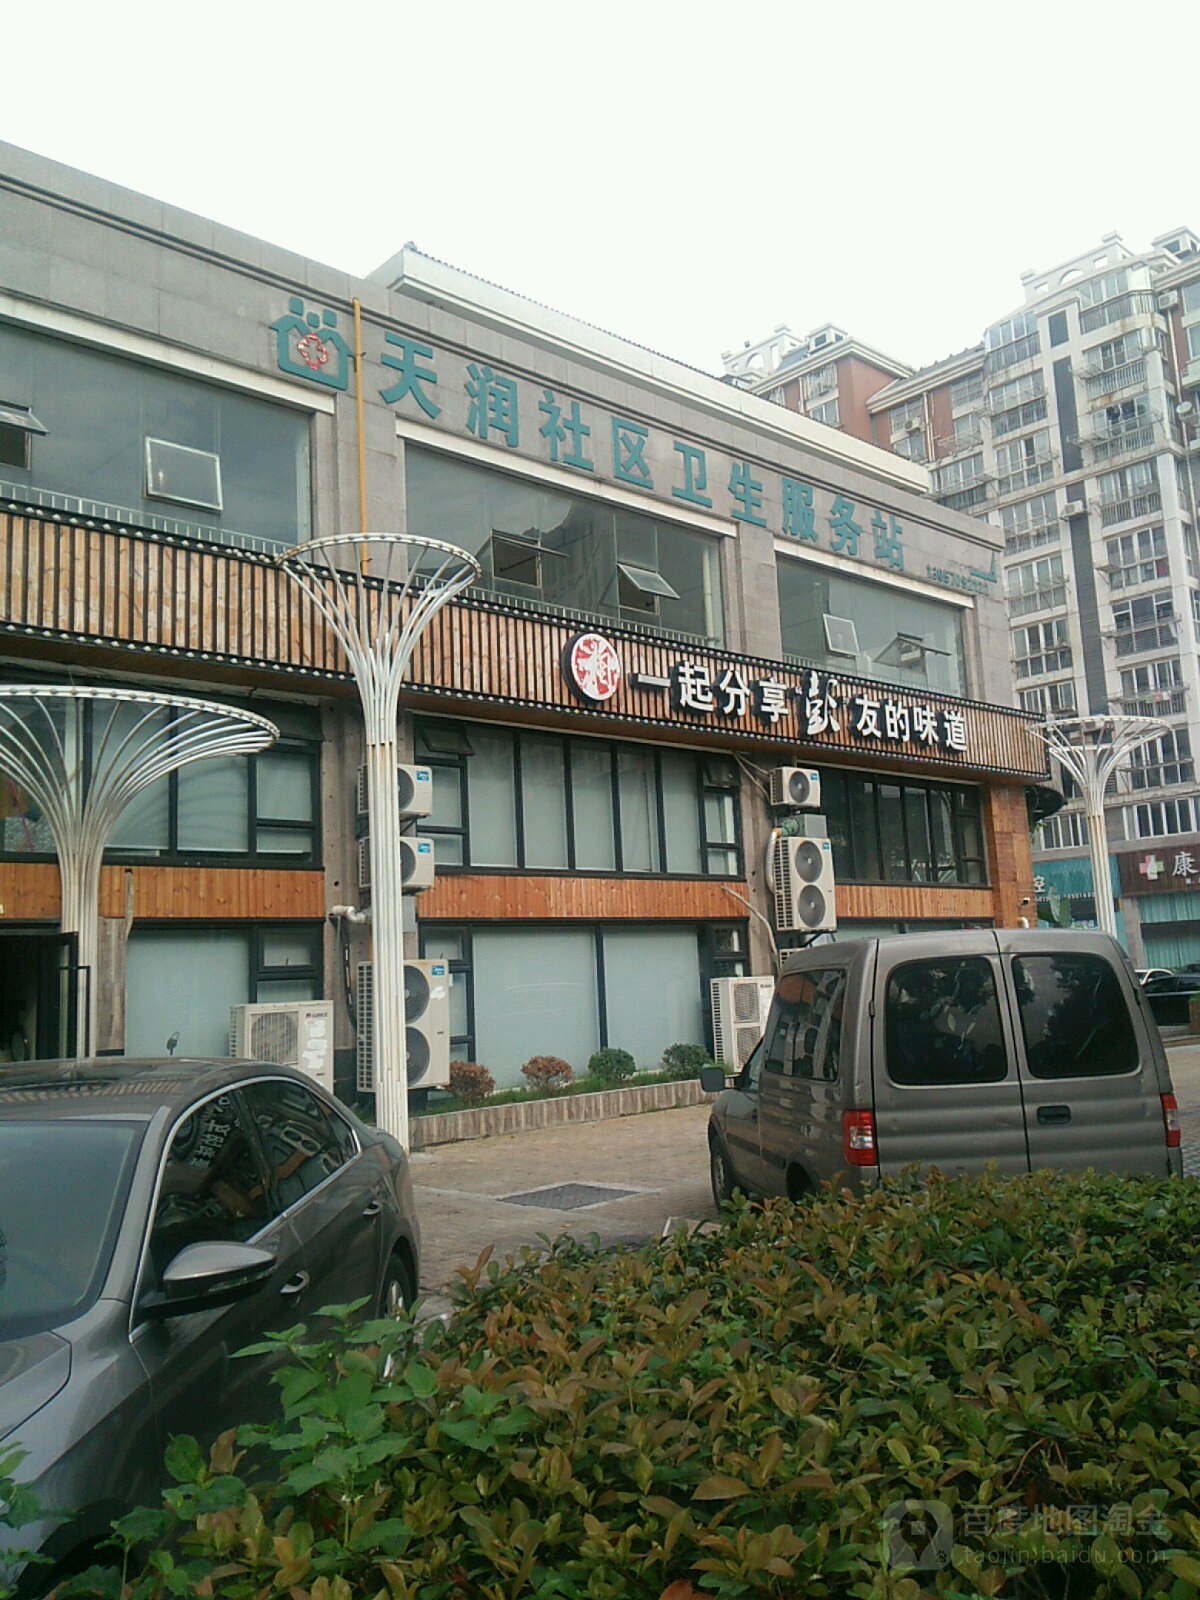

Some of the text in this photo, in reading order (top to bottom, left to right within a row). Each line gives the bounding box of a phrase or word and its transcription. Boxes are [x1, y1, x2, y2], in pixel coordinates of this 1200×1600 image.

[379, 332, 905, 571] 天润社区卫生服务站
[1172, 851, 1199, 877] 康
